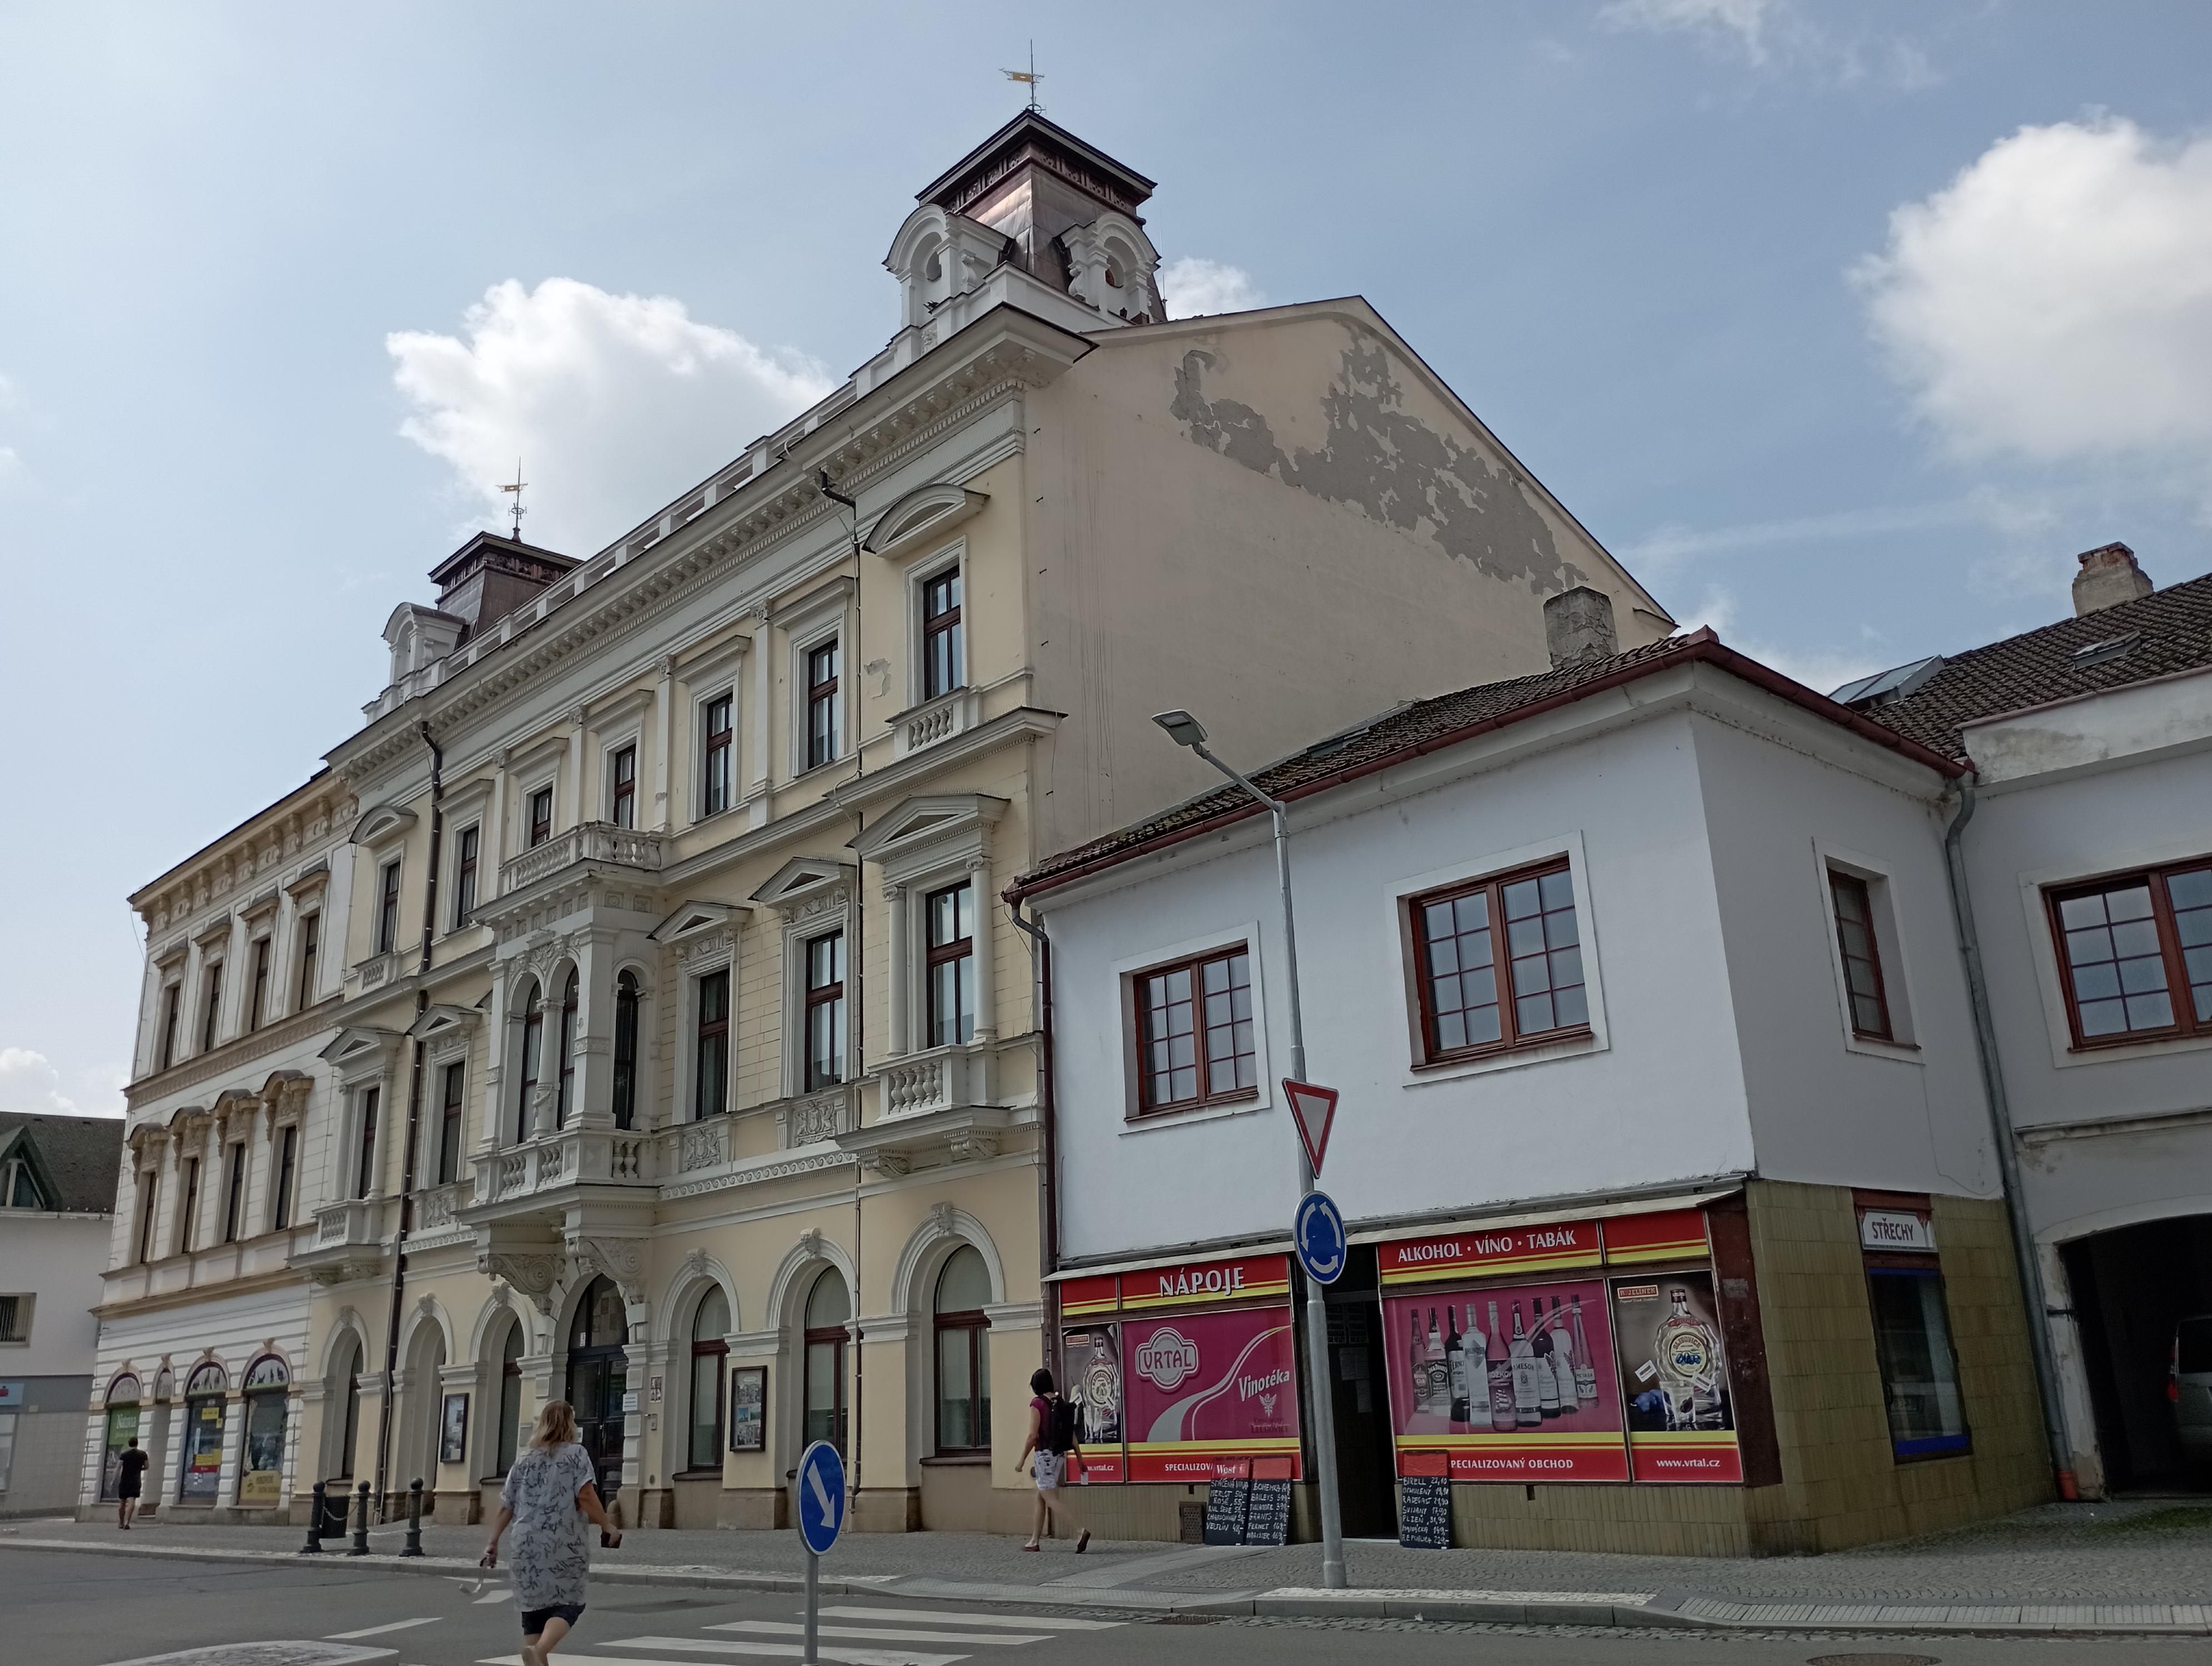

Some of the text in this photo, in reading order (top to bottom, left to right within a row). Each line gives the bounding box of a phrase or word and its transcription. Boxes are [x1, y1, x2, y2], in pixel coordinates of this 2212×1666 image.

[1872, 1217, 1913, 1241] STŘECHY
[1398, 1226, 1576, 1262] ALKOHOL VÍNO TABÁK
[1159, 1267, 1245, 1297] NÁPOJE
[1144, 1349, 1192, 1369] VRTAL
[1238, 1368, 1290, 1402] Vinotéka
[1450, 1457, 1573, 1468] PECIALIZOVANÝ OBCHOD
[1656, 1458, 1720, 1468] www.vrtal.cz
[1216, 1464, 1236, 1474] West
[1403, 1477, 1426, 1486] BIRELL
[1210, 1489, 1233, 1498] MERLOT
[1251, 1493, 1274, 1502] BAILEYS
[1402, 1506, 1427, 1515] SVIJANY
